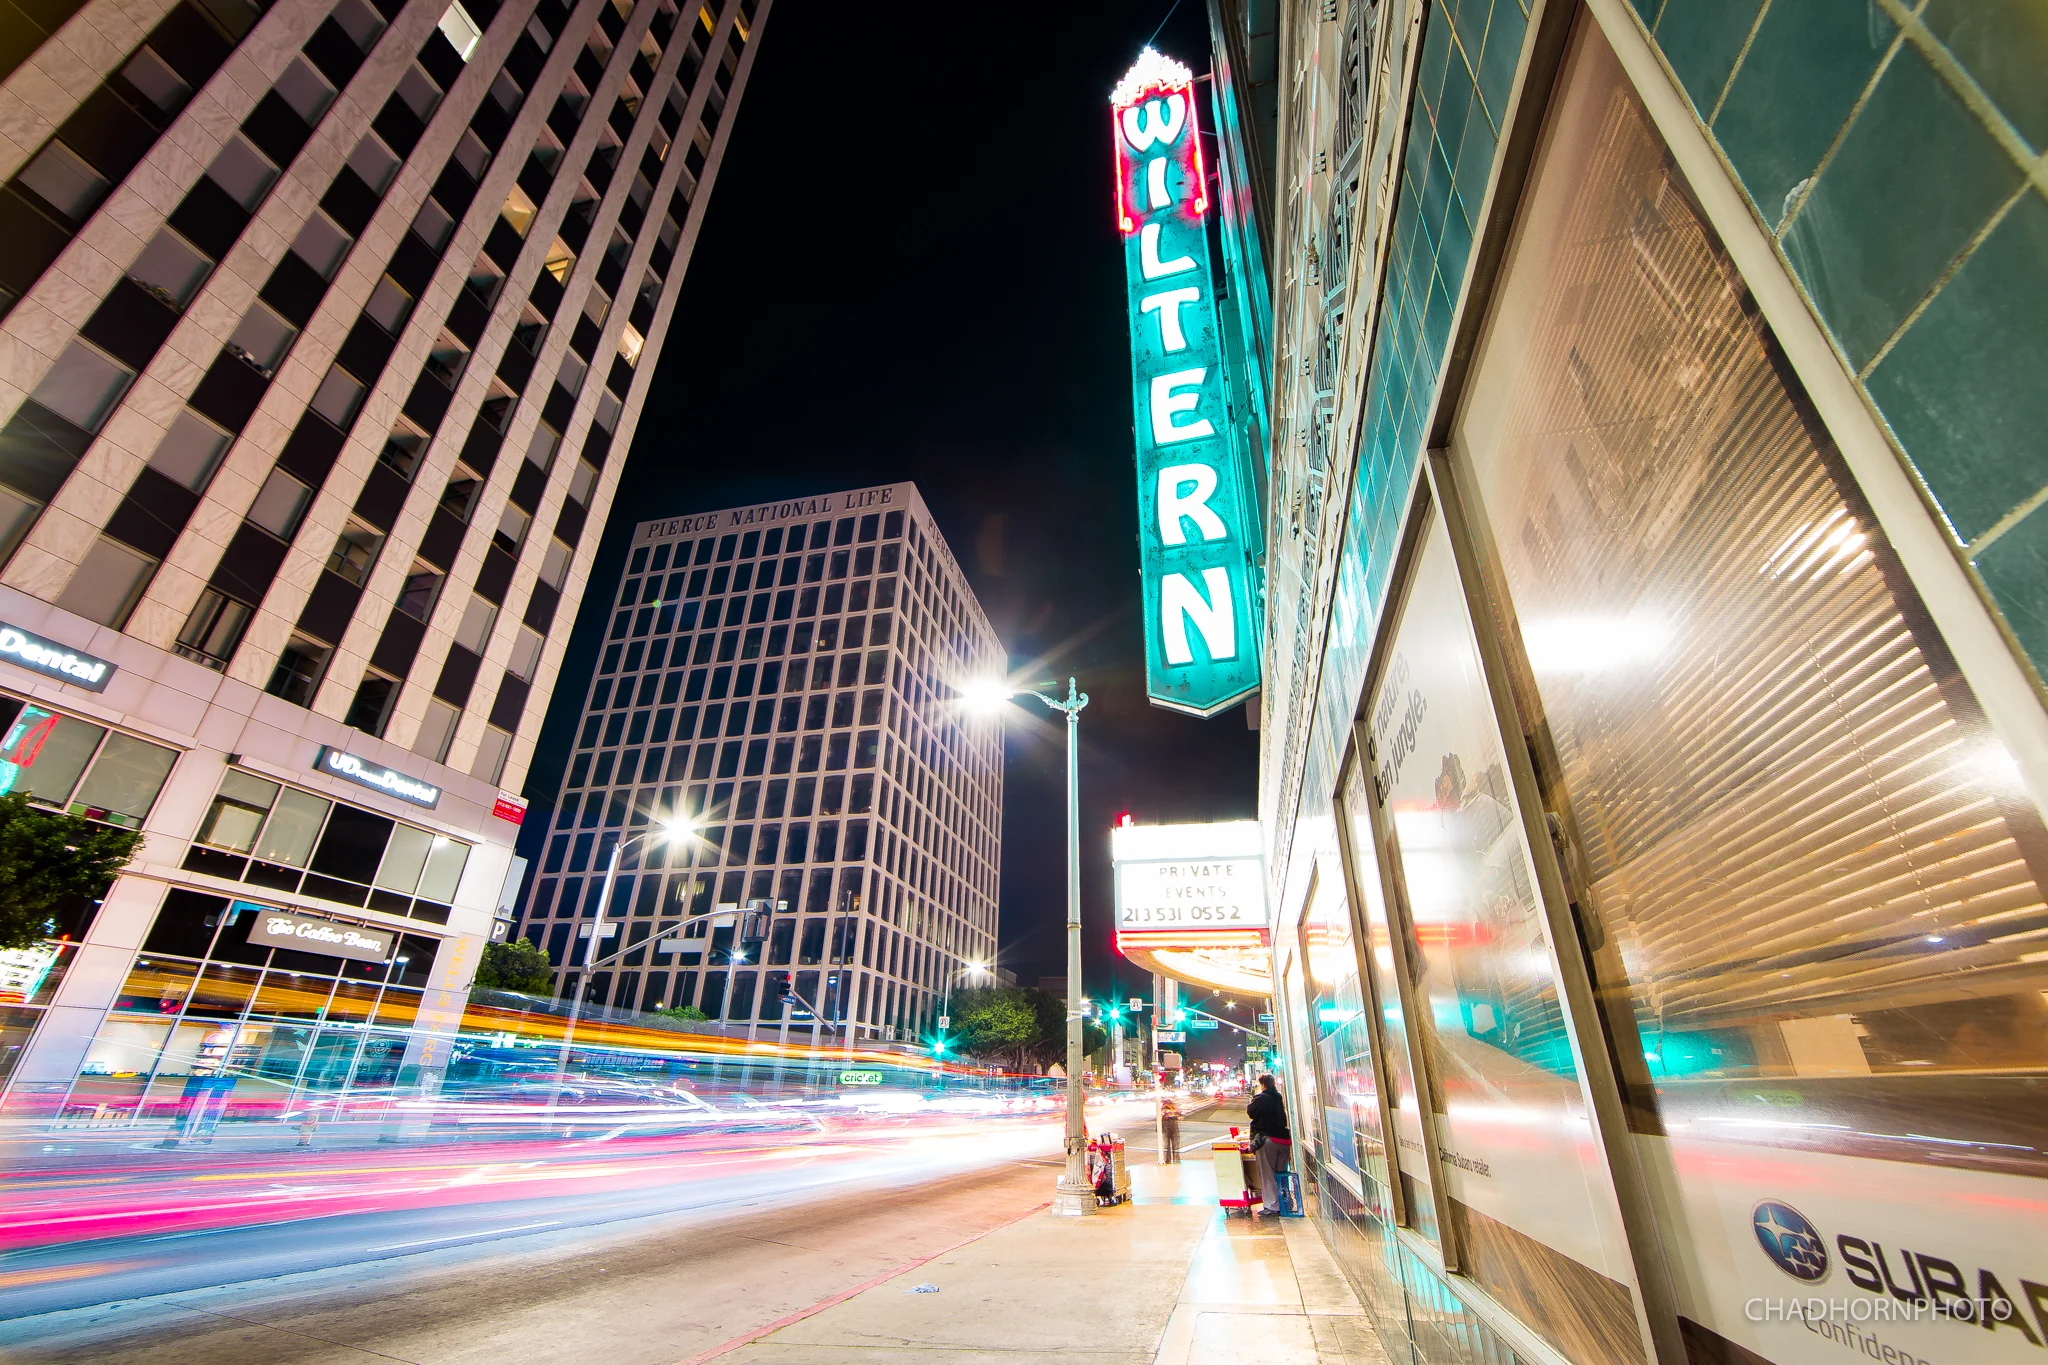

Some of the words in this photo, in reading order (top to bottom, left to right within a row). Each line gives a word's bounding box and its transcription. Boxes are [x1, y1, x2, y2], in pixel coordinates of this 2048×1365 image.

[1122, 93, 1237, 667] WILTERN
[646, 513, 719, 539] PIERCE
[729, 498, 833, 527] NATIONAL
[845, 488, 894, 510] LIFE
[927, 514, 956, 573] PIERCE
[0, 628, 107, 683] Dental
[1159, 864, 1235, 878] PRIVATE
[1165, 885, 1227, 899] EVENTS
[491, 921, 506, 939] P
[1123, 907, 1151, 922] 213
[1156, 906, 1182, 922] 531
[1191, 905, 1242, 921] 0552
[437, 936, 470, 1008] WELLS
[419, 1012, 446, 1067] FARG
